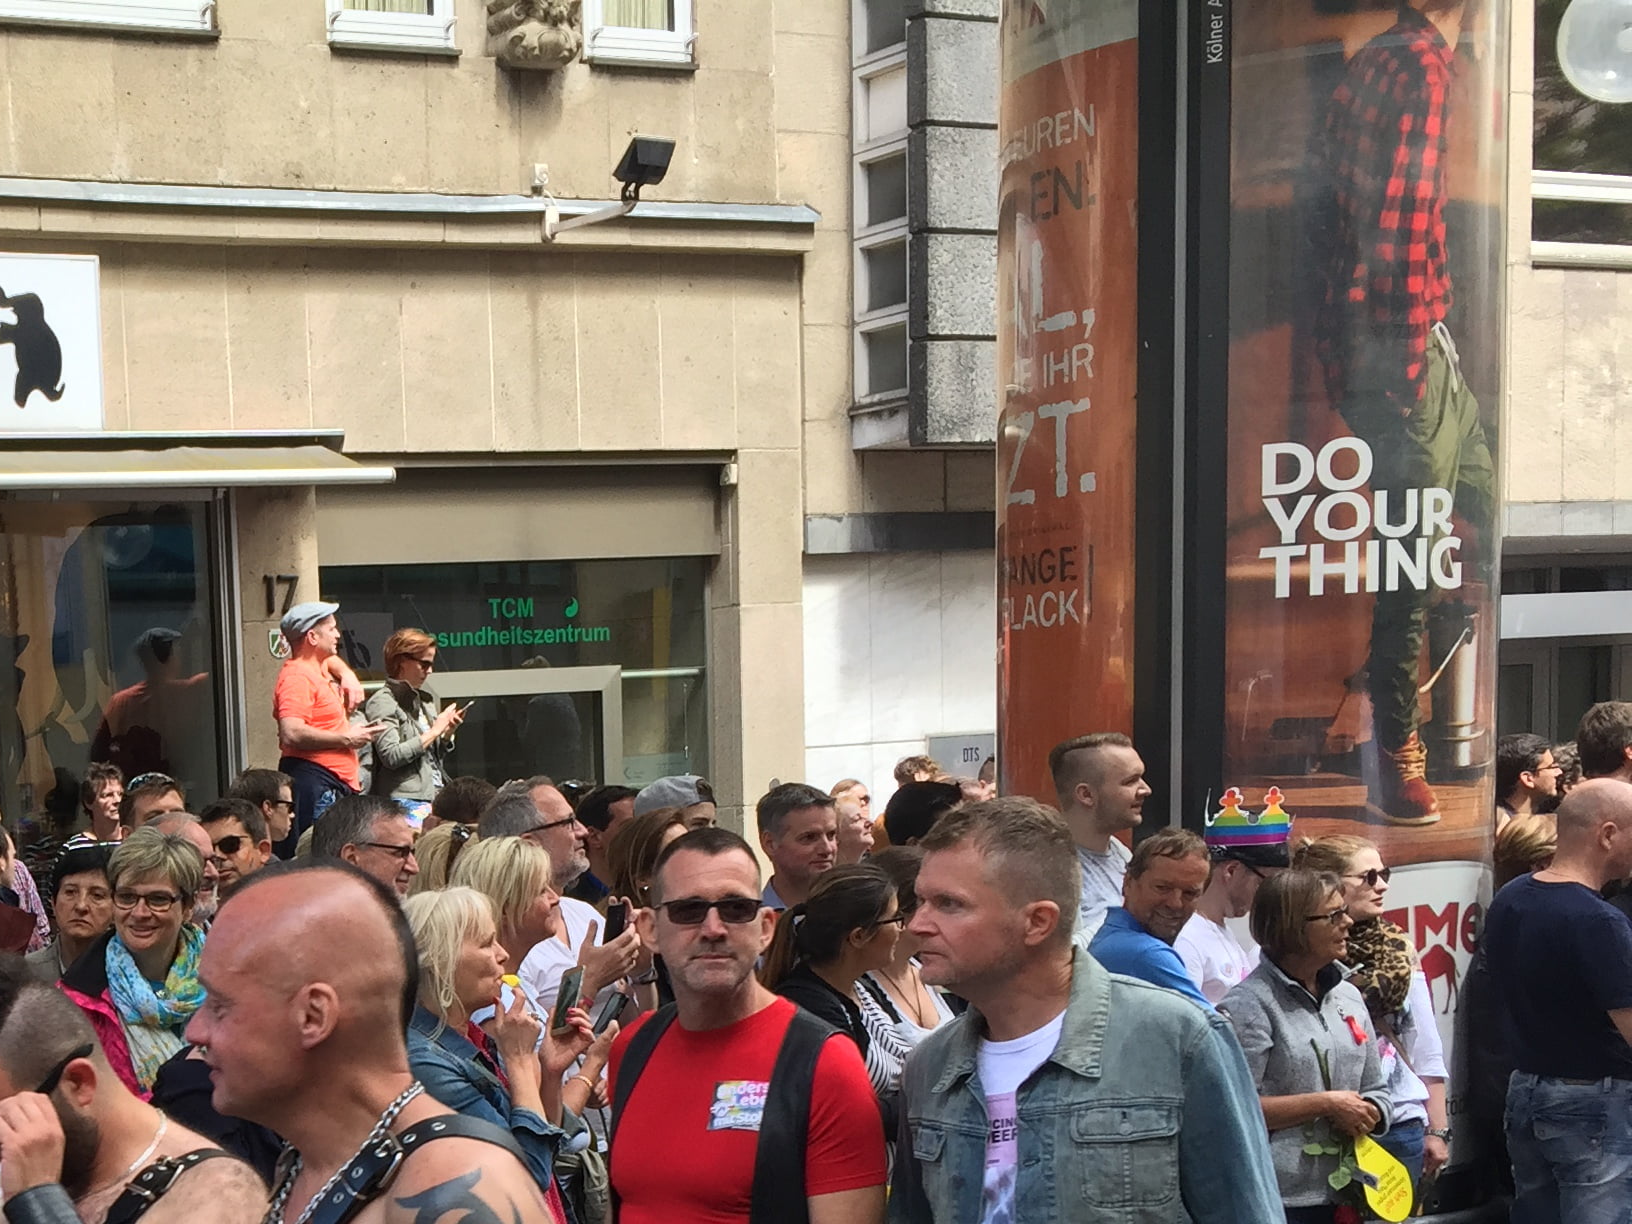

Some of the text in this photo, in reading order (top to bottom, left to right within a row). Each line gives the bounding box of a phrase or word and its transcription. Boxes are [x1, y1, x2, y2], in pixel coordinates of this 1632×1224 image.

[1206, 14, 1223, 63] Kölner
[1043, 343, 1094, 389] IHR
[1262, 436, 1373, 496] DO
[1262, 487, 1454, 545] YOUR
[1258, 536, 1462, 599] THING
[263, 574, 299, 618] 17
[488, 597, 534, 619] TCM
[418, 624, 611, 649] sundheitszentrum
